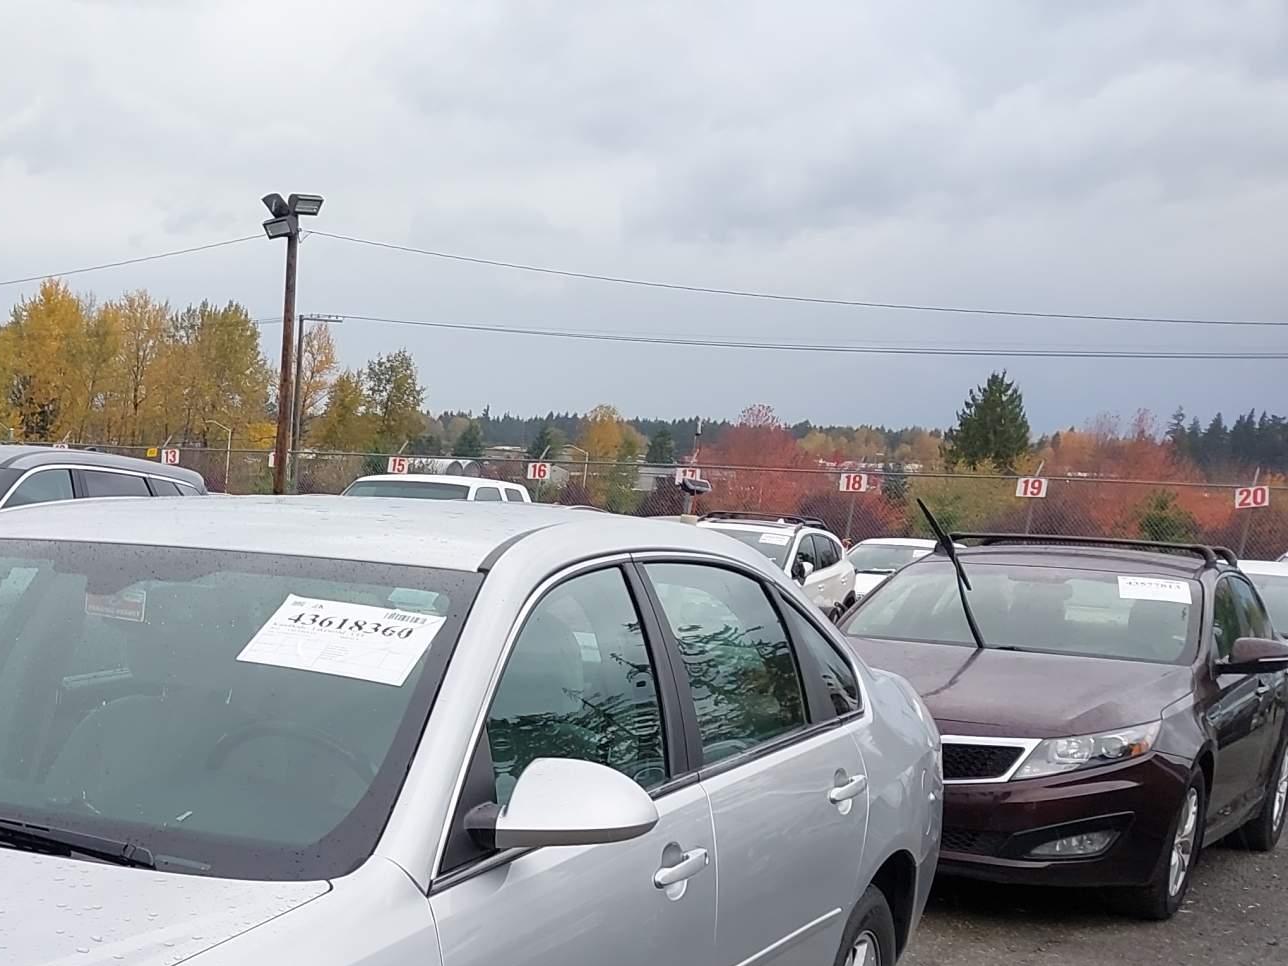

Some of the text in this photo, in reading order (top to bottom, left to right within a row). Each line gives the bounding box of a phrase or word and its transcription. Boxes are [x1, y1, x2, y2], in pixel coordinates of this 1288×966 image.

[164, 450, 177, 464] 13
[391, 457, 406, 472] 15
[531, 463, 547, 478] 16
[845, 474, 862, 490] 18
[1022, 479, 1043, 496] 19
[1238, 487, 1266, 507] 20
[288, 612, 414, 640] 43618360
